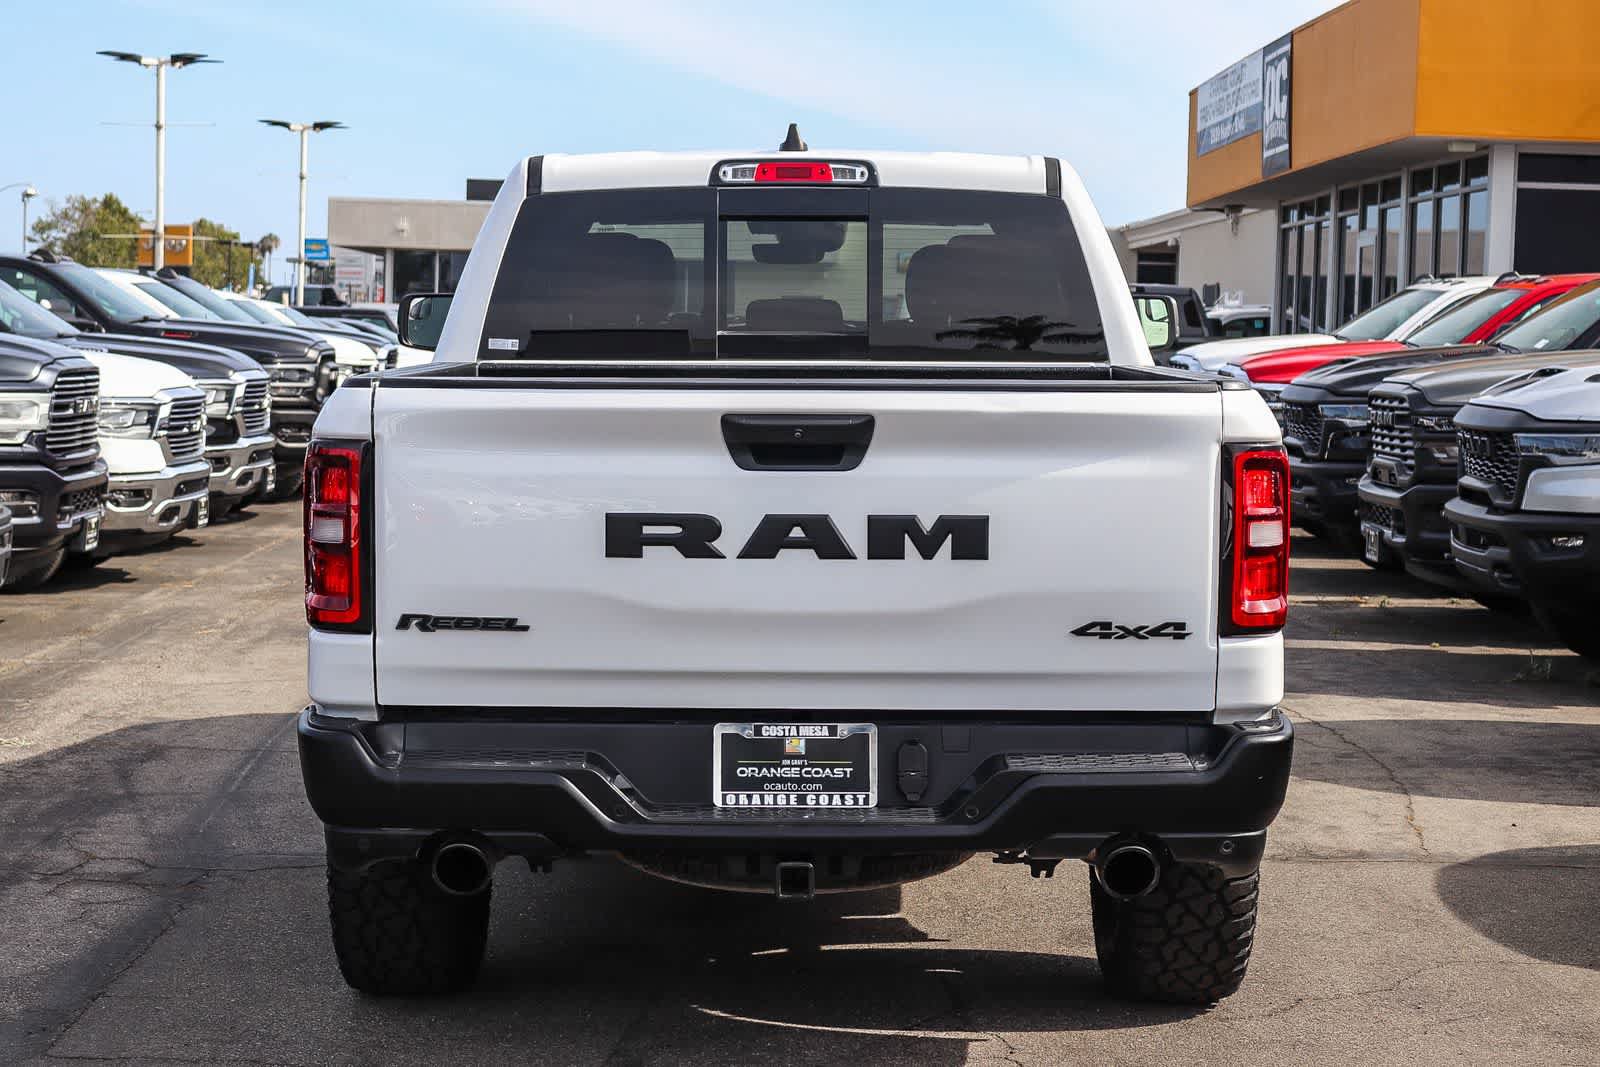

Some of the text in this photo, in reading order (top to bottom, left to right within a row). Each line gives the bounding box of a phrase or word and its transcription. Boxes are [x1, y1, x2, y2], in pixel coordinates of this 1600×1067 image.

[605, 512, 989, 560] RAM
[395, 613, 530, 632] REBEL
[1069, 621, 1193, 640] 4x4
[761, 725, 829, 737] COSTA MESA
[736, 767, 853, 778] ORANGE COAST
[763, 782, 822, 791] ocauto.com
[725, 793, 866, 806] ORANGE COAST
